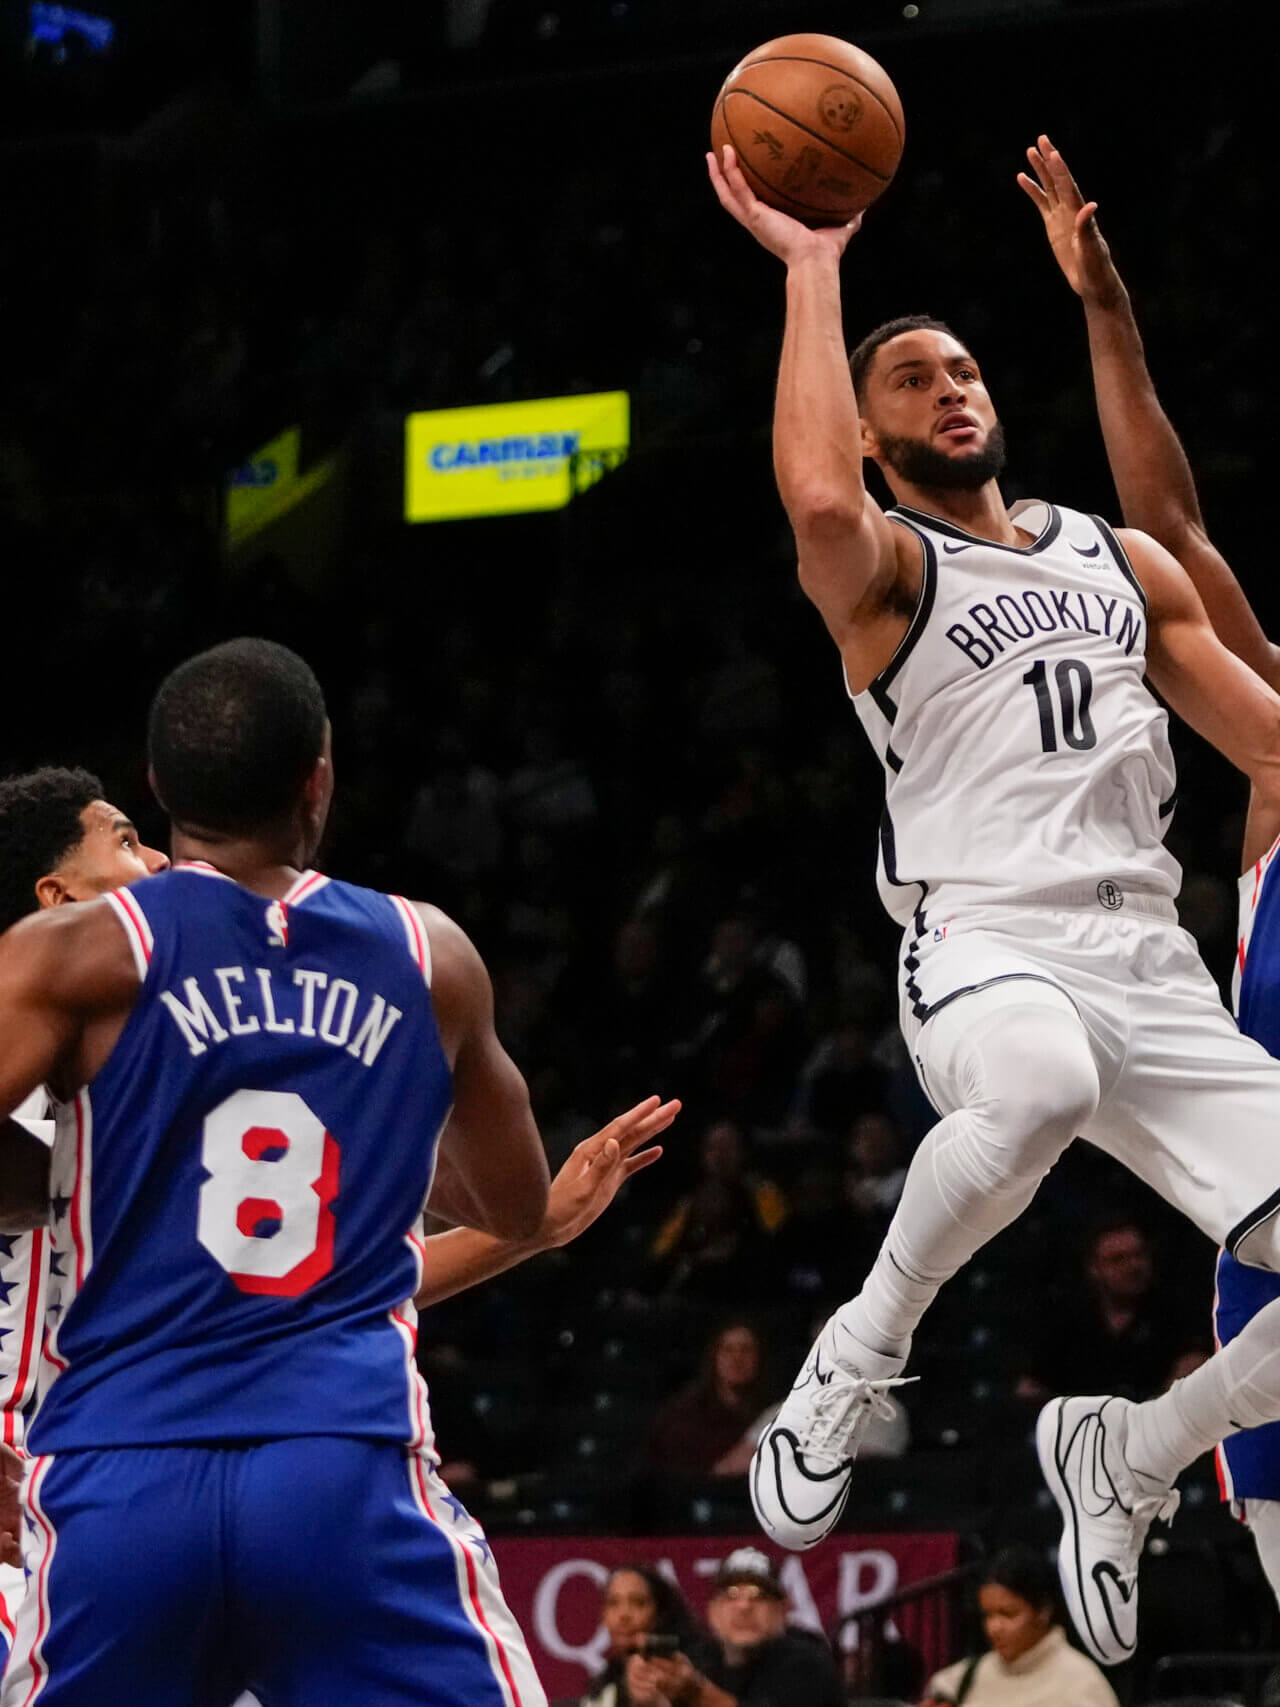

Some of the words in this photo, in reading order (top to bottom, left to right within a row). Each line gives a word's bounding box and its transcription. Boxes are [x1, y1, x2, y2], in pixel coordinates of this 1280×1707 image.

[945, 589, 1142, 669] BROOKLYN
[1022, 658, 1097, 753] 10
[160, 965, 402, 1068] MELTON
[196, 1088, 342, 1298] 8
